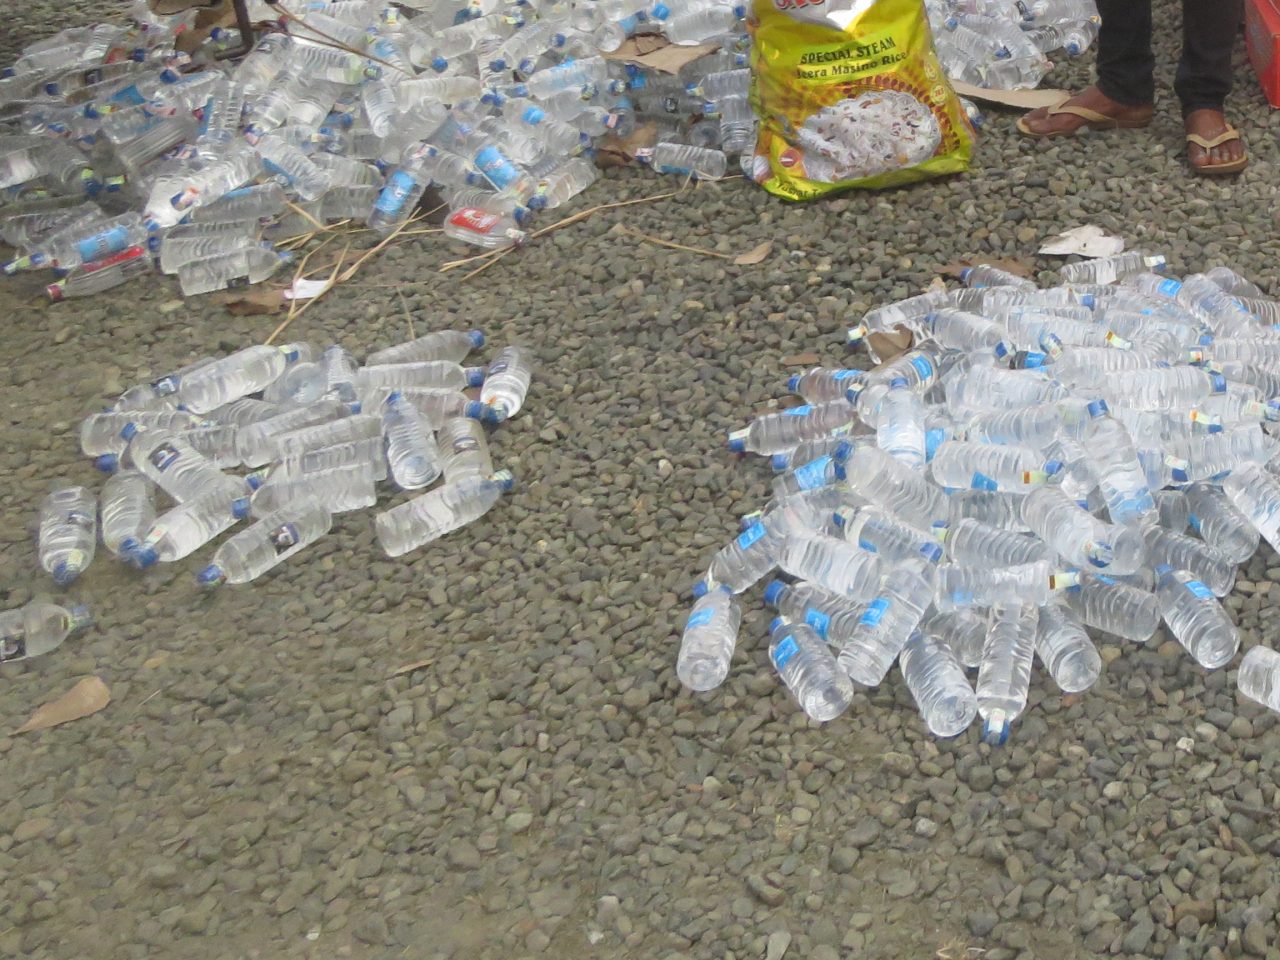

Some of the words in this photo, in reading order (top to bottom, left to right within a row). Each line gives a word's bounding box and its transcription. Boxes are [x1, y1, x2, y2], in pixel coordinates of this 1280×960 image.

[800, 48, 854, 65] SPECIAL
[856, 36, 897, 58] STEAM
[832, 60, 878, 76] Masino
[881, 51, 907, 66] Rice
